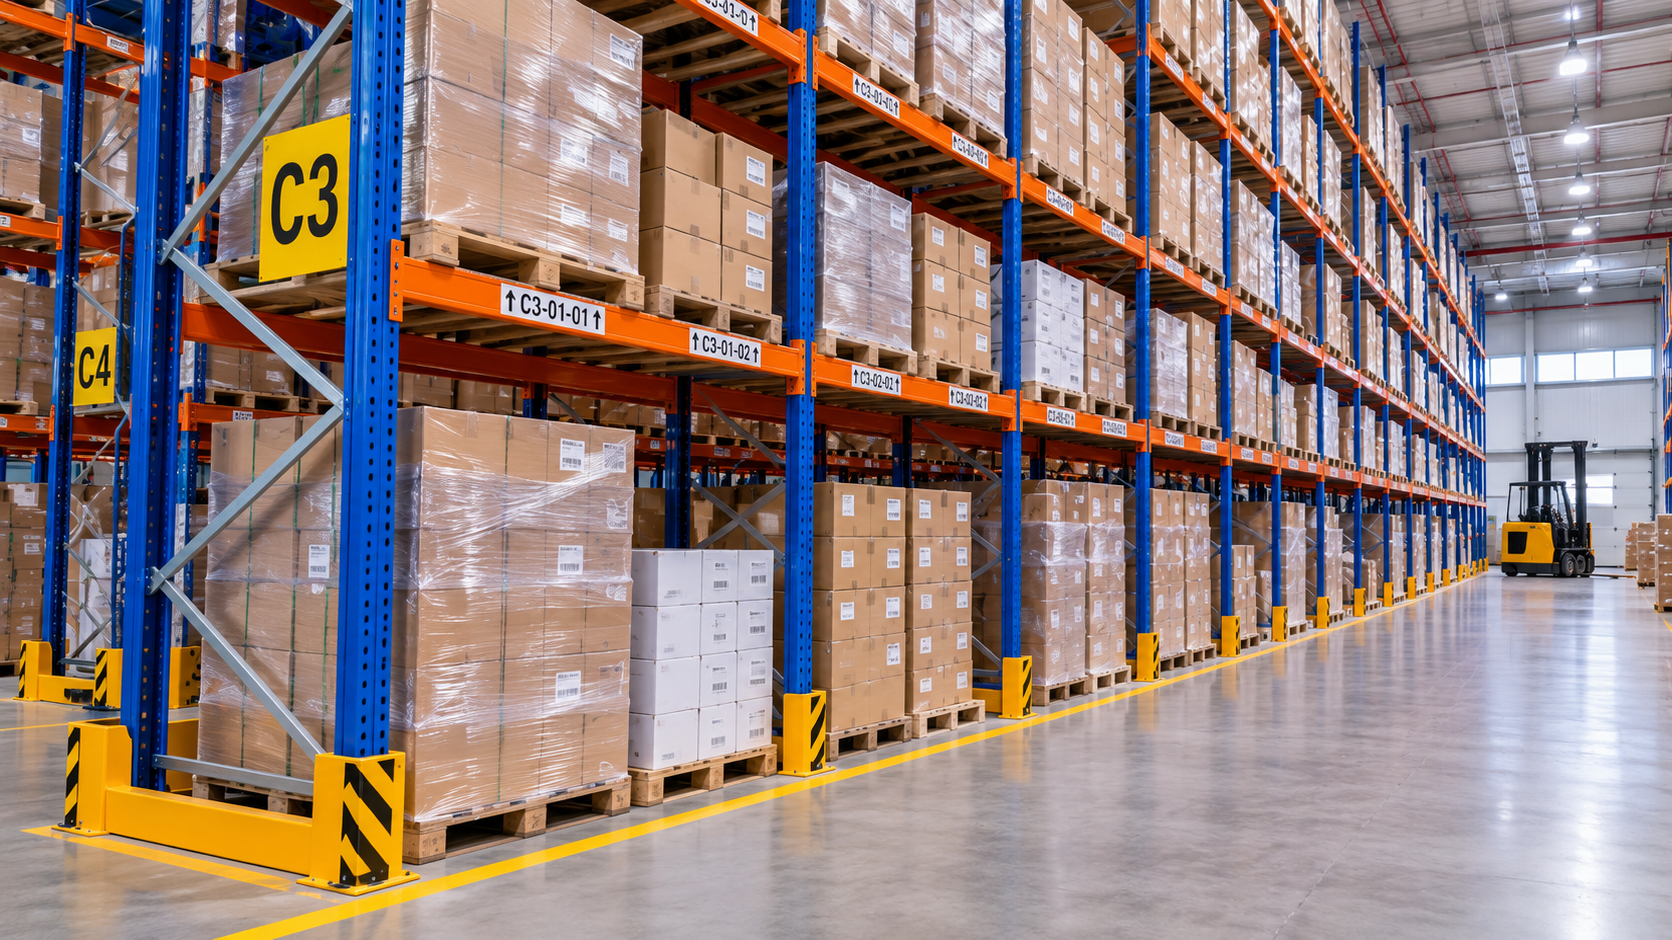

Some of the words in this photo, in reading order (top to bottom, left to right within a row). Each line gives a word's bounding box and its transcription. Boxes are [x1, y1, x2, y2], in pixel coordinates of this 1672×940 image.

[270, 153, 339, 245] C3
[520, 293, 588, 327] C3-01-01
[78, 344, 111, 389] C4
[702, 335, 750, 361] C3-01-02
